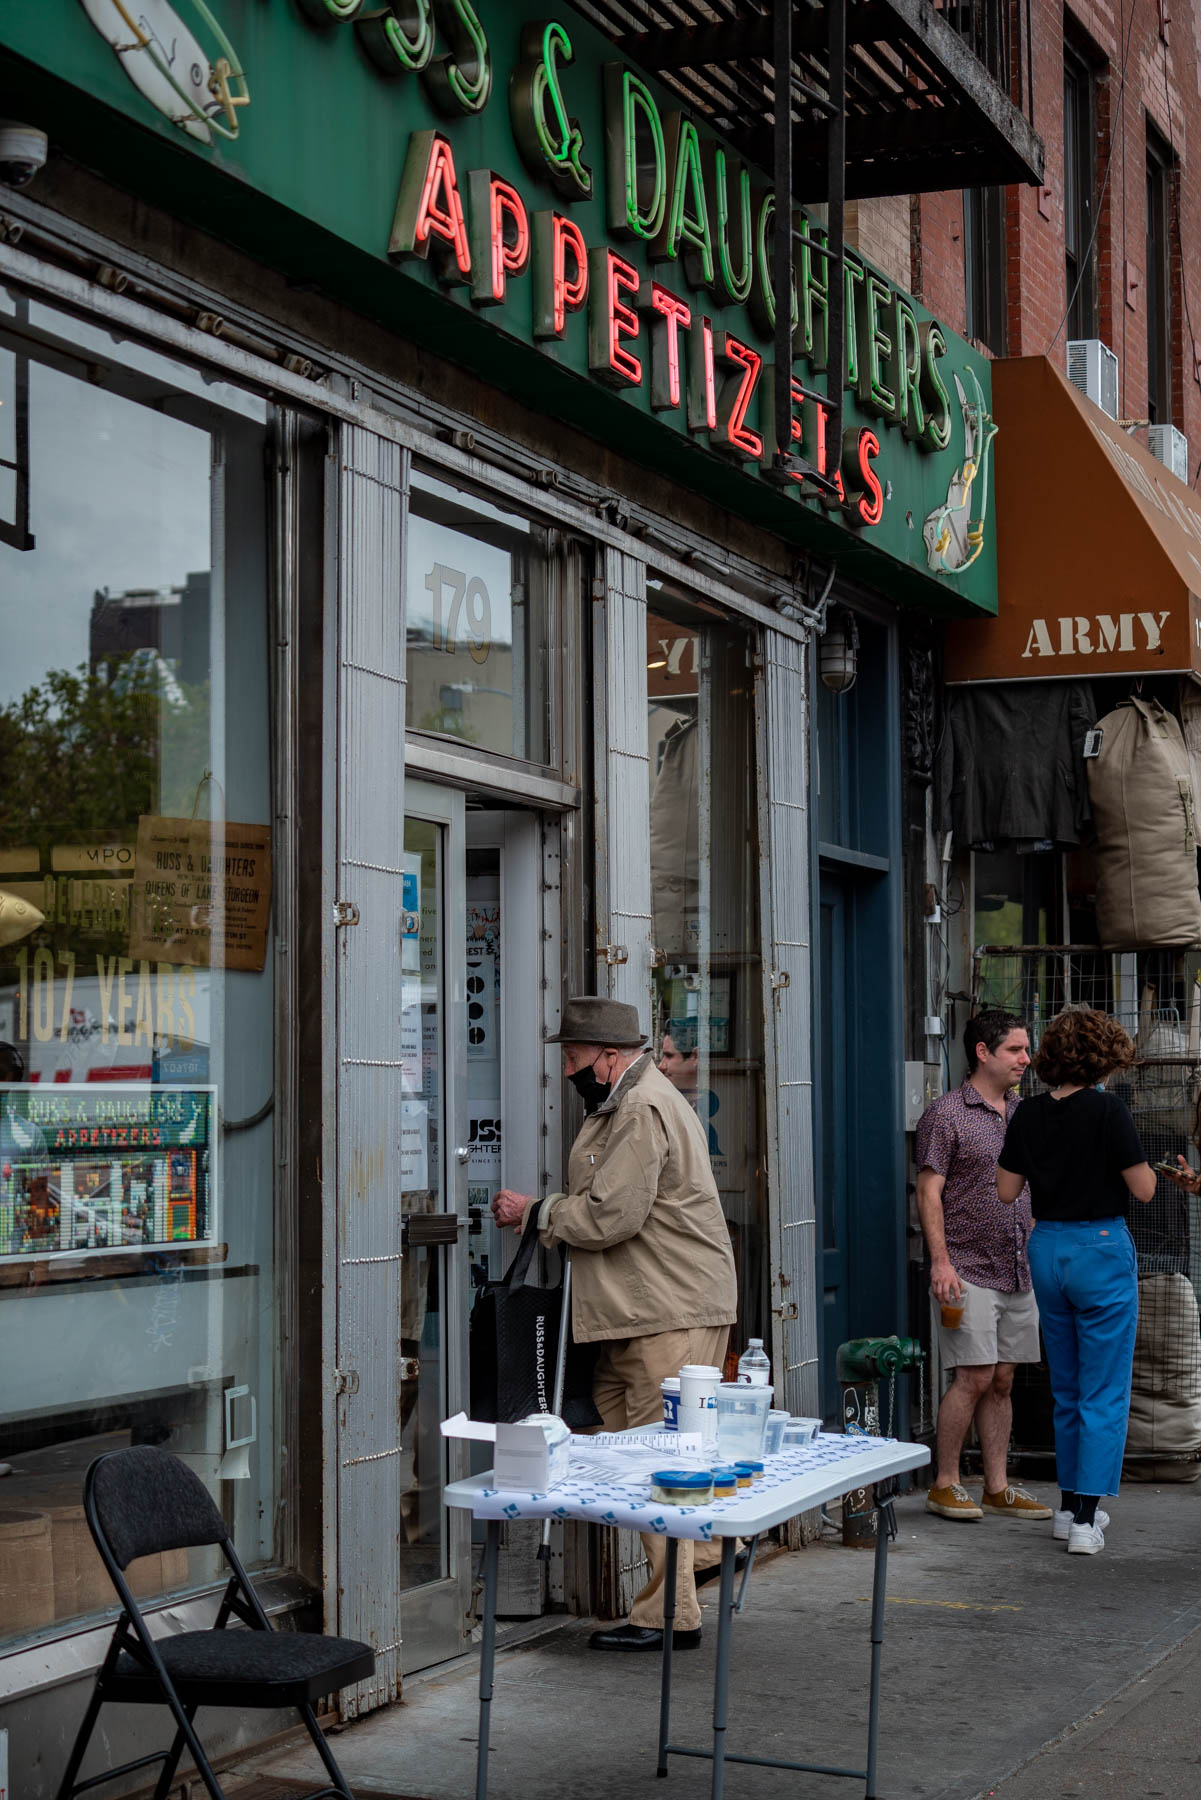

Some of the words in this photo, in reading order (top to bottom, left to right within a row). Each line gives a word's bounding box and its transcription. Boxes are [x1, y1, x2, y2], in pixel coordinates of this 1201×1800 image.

[514, 20, 593, 201] &
[605, 62, 952, 451] DAUGHTERS
[391, 131, 882, 526] APPETIZS
[425, 562, 491, 664] 179
[1021, 611, 1170, 657] ARMY
[145, 880, 176, 897] QUEENS
[181, 883, 190, 898] OF
[156, 851, 181, 871] RUSS
[186, 855, 194, 872] &
[16, 946, 76, 1043] 107
[96, 953, 196, 1052] YEARS
